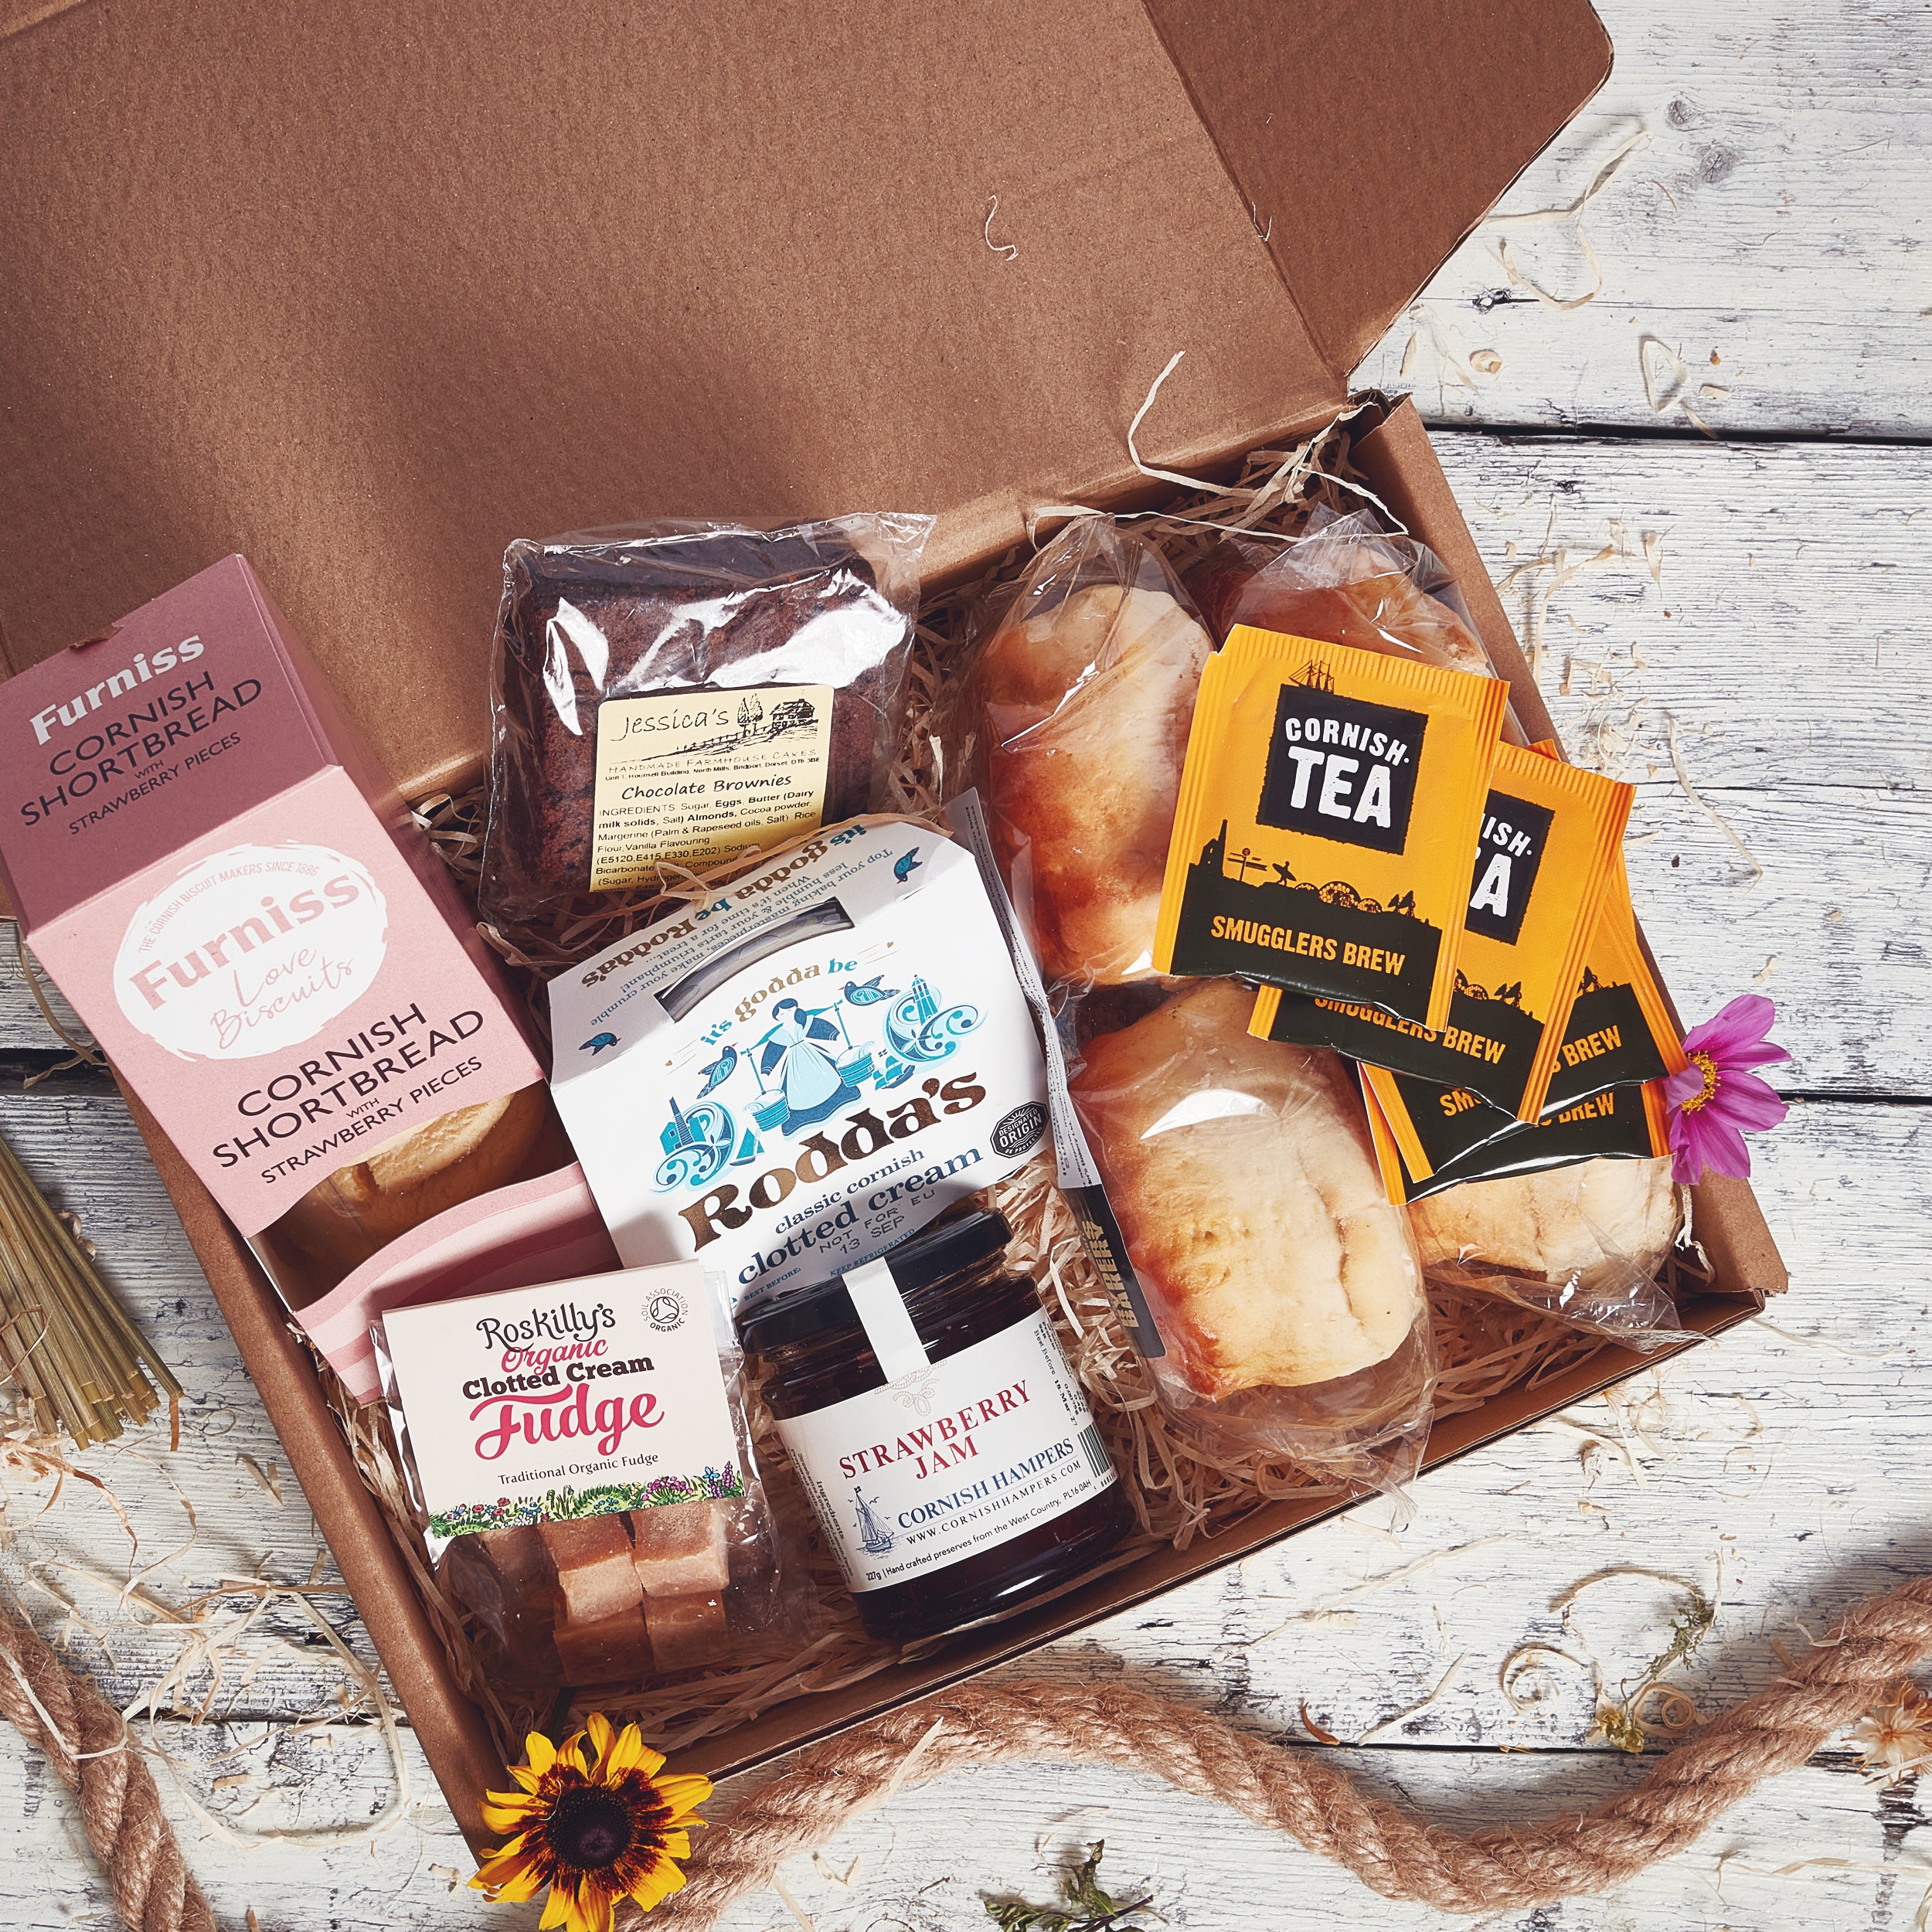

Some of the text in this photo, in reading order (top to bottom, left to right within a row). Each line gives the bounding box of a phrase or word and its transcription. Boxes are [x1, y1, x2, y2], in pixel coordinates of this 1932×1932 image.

[30, 635, 204, 745] Furniss
[49, 671, 215, 775] CORNISH
[611, 709, 729, 741] Jessica's
[21, 679, 261, 825] SHORTBREAD
[134, 760, 164, 779] WITH
[610, 749, 816, 773] HANDMADE FARMHOUSE CAKES
[70, 732, 240, 834] STRAWBERRY PIECES
[621, 774, 791, 800] Chocolate Brownies
[749, 794, 780, 804] Butter
[783, 790, 814, 801] (Dairy
[1287, 746, 1390, 828] TEA
[598, 820, 621, 828] milk
[740, 806, 771, 815] Cocoa
[651, 828, 679, 838] (Palm
[692, 822, 741, 834] Rapeseed
[767, 814, 788, 825] Salt)
[794, 811, 816, 819] Rice
[660, 837, 709, 848] Flavouring
[868, 849, 893, 864] Top
[596, 866, 655, 874] Bicarbonate
[733, 841, 828, 900] godda
[775, 875, 811, 895] When
[839, 856, 866, 879] your
[138, 862, 319, 953] THE CORNISH BISCUIT MAKERS SINCE 1886
[694, 898, 733, 921] be
[721, 903, 750, 920] time
[752, 893, 772, 907] it's
[791, 878, 837, 909] baking
[129, 875, 360, 1011] Furniss
[619, 861, 849, 994] less humble & your tarts triumphant!
[689, 934, 698, 943] a
[699, 918, 719, 934] for
[1211, 915, 1405, 975] SMUGGLERS BREW
[581, 919, 696, 988] Rodda's
[668, 952, 704, 975] make
[233, 947, 317, 1007] Love
[639, 967, 668, 988] your
[210, 957, 354, 1050] Biscuits
[590, 988, 638, 1028] crumble
[700, 958, 859, 1046] it's godda be
[237, 1003, 427, 1116] CORNISH
[1442, 1026, 1505, 1064] BREW
[1562, 1025, 1621, 1066] BREW
[213, 1009, 484, 1168] SHORTBREAD
[346, 1097, 379, 1118] WITH
[1559, 1093, 1614, 1123] BREW
[261, 1056, 482, 1184] STRAWBERRY PIECES
[998, 1109, 1037, 1136] DESIGNATED
[1000, 1114, 1042, 1147] ORIGIN
[679, 1072, 986, 1253] Rodda's
[775, 1148, 925, 1235] classic cornish
[739, 1201, 859, 1285] clotted
[868, 1147, 983, 1211] cream
[819, 1189, 936, 1253] NOT FOR EU
[839, 1215, 905, 1254] 13 SEP
[830, 1228, 917, 1277] KEEP REFRIGERATED
[743, 1267, 801, 1301] BEST BEFORE:
[1089, 1217, 1140, 1329] BAKERY
[641, 1288, 688, 1321] SOIL ASSOCIATION
[476, 1303, 615, 1353] Roskilly's
[650, 1318, 685, 1332] ORGANIC
[501, 1338, 608, 1376] Organic
[1041, 1349, 1056, 1375] Before
[463, 1357, 655, 1400] Clotted Cream
[470, 1383, 665, 1460] Fudge
[838, 1380, 1031, 1480] STRAWBERRY
[498, 1452, 659, 1485] Traditional Organic Fudge
[915, 1435, 980, 1479] JAM
[897, 1484, 991, 1529] CORNISH
[992, 1438, 1075, 1491] HAMPERS
[906, 1461, 1081, 1545] WWW.CORNISHHAMPERS.COM
[816, 1480, 845, 1539] Ingredients
[866, 1570, 882, 1582] 227g
[886, 1559, 903, 1576] Hand
[905, 1553, 933, 1570] crafted
[934, 1541, 972, 1561] preserves
[973, 1531, 994, 1547] from
[994, 1524, 1008, 1537] the
[1008, 1516, 1029, 1530] West
[1030, 1499, 1063, 1519] Country,
